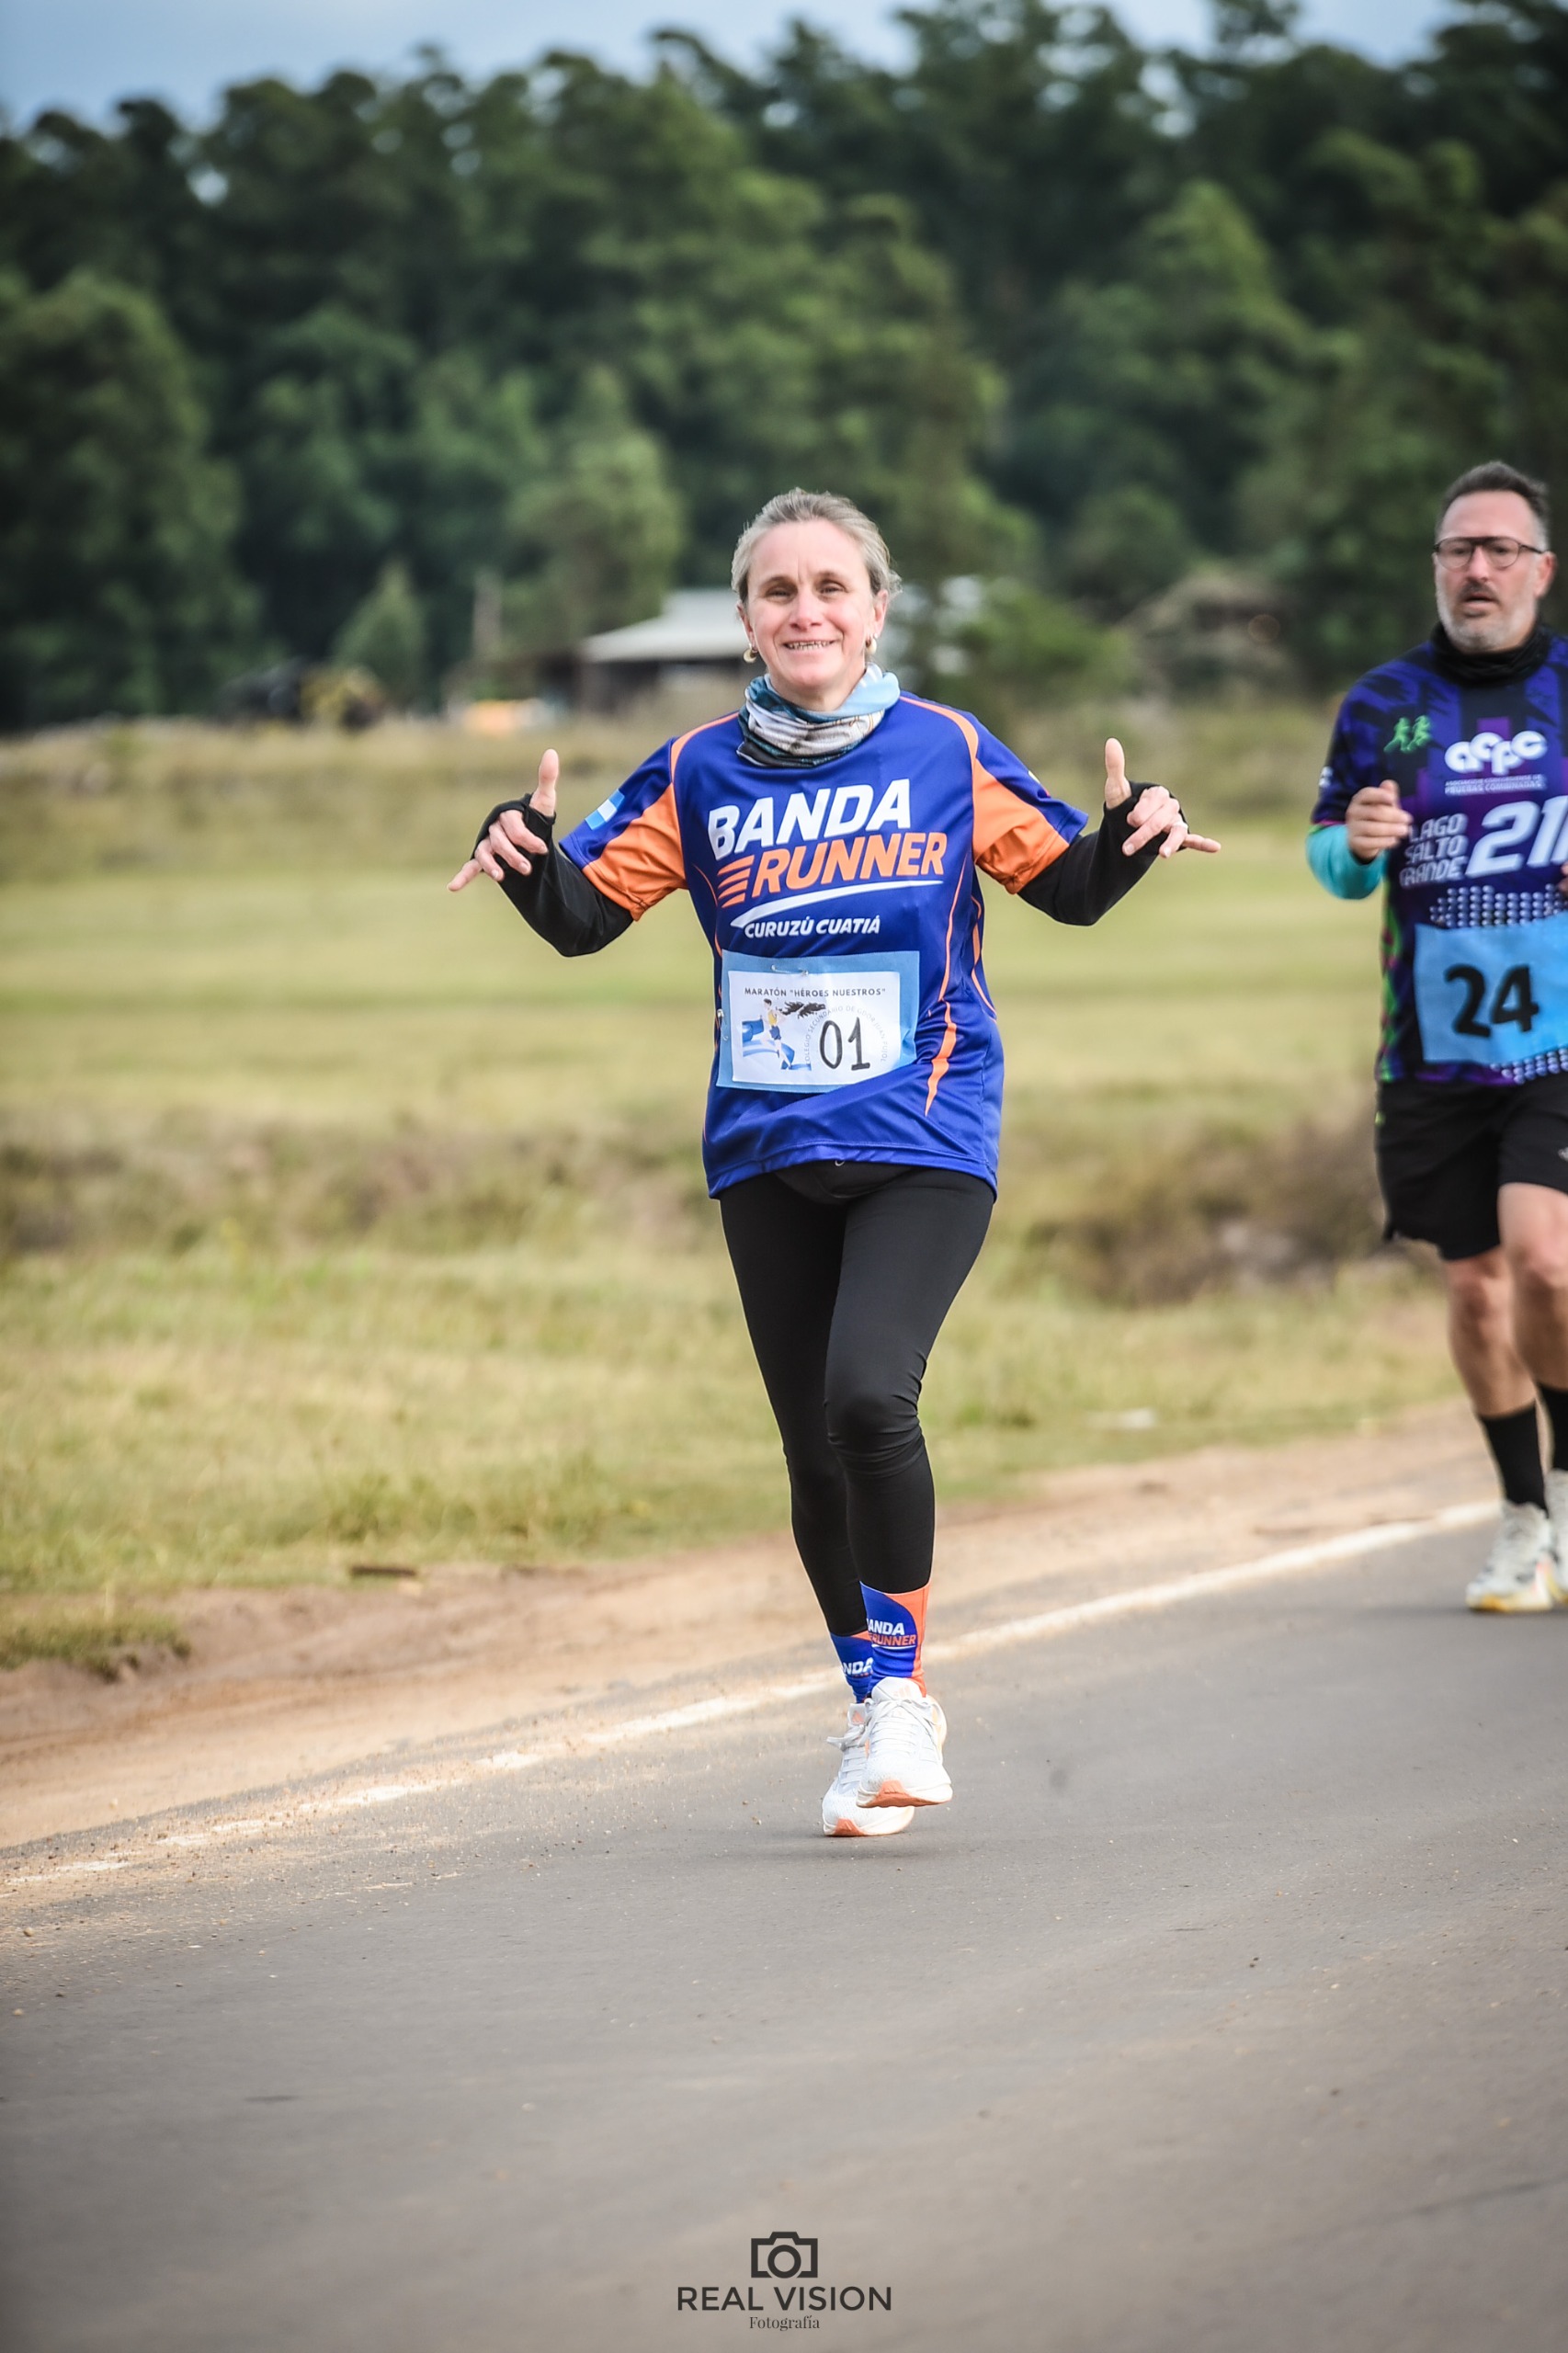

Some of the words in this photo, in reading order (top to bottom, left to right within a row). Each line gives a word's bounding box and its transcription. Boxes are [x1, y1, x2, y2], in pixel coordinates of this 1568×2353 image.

[708, 779, 911, 860] BANDA
[1408, 813, 1469, 843] LAGO
[1404, 835, 1469, 864] SALTO
[752, 832, 948, 898] RUNNER
[744, 916, 813, 938] CURUZÚ
[816, 915, 881, 934] CUATIÁ
[744, 986, 787, 996] MARATÓN
[1443, 963, 1540, 1038] 24
[819, 1017, 871, 1071] 01
[867, 1619, 905, 1636] ANDA
[871, 1633, 916, 1646] RUNNER
